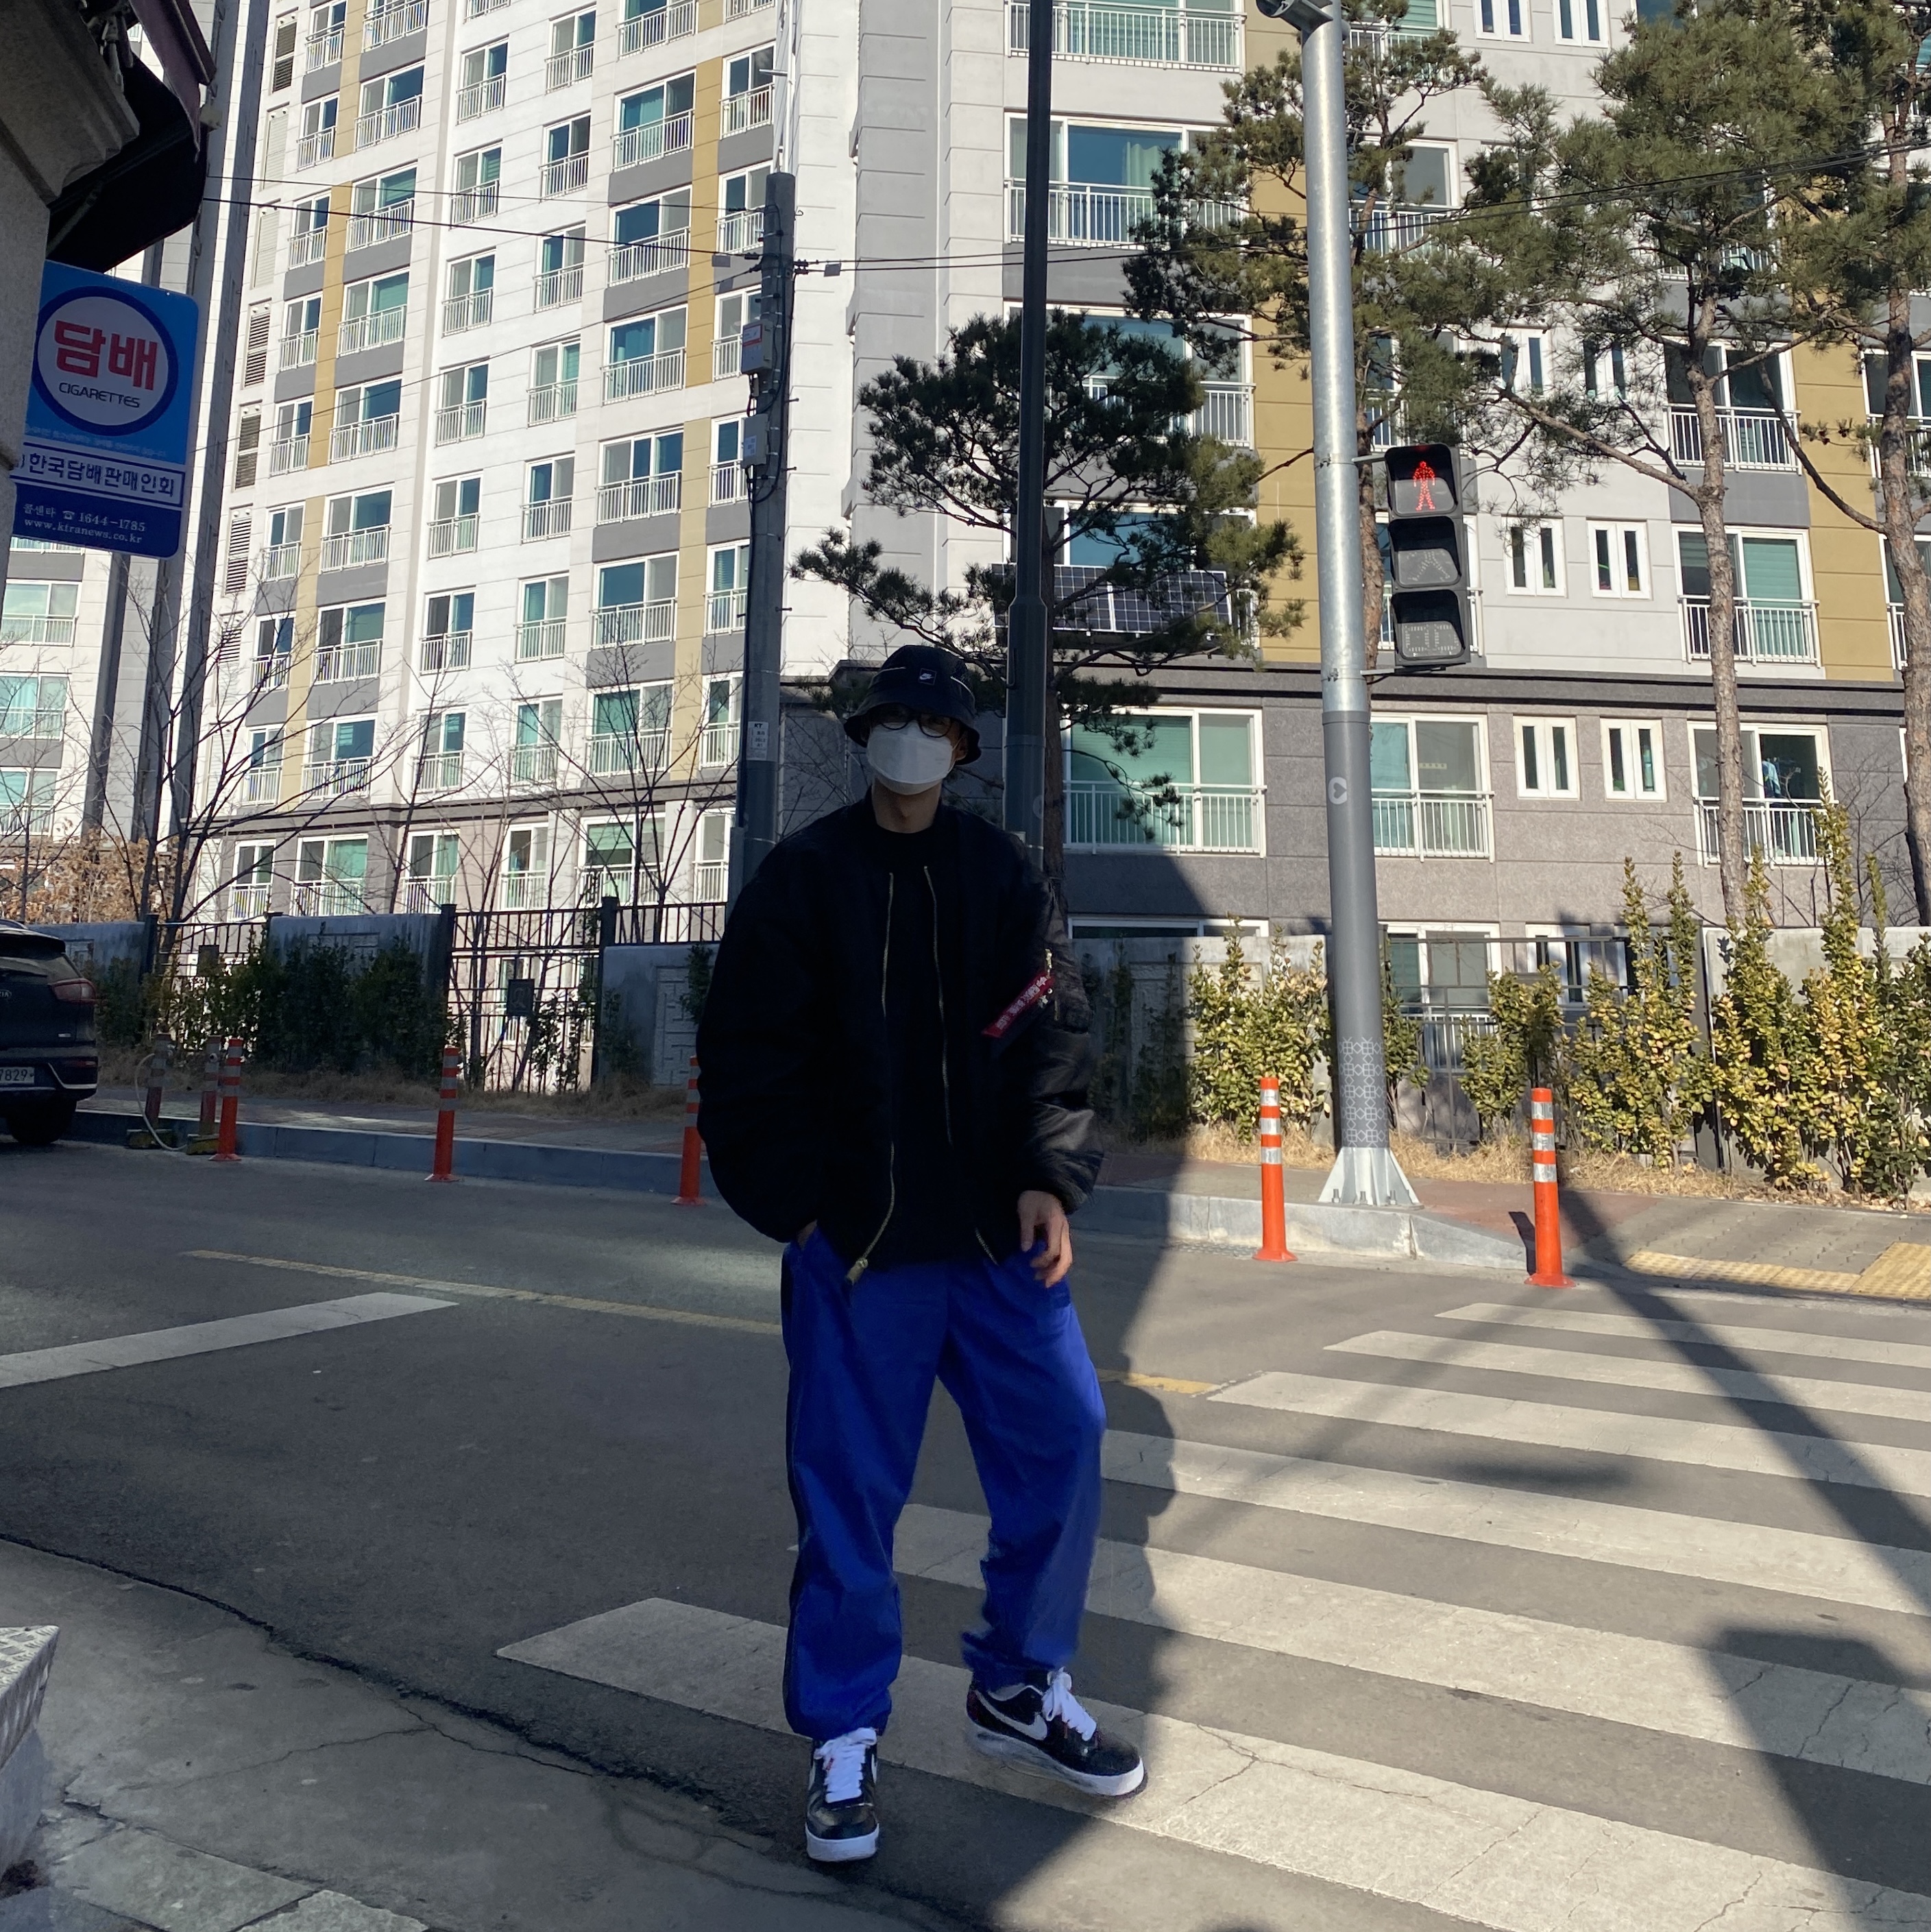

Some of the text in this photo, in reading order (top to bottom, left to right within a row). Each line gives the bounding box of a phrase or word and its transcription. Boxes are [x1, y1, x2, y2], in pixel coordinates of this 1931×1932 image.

[54, 320, 158, 391] 담배
[59, 382, 141, 409] CIGARETTES
[78, 513, 146, 532] 1644-1785
